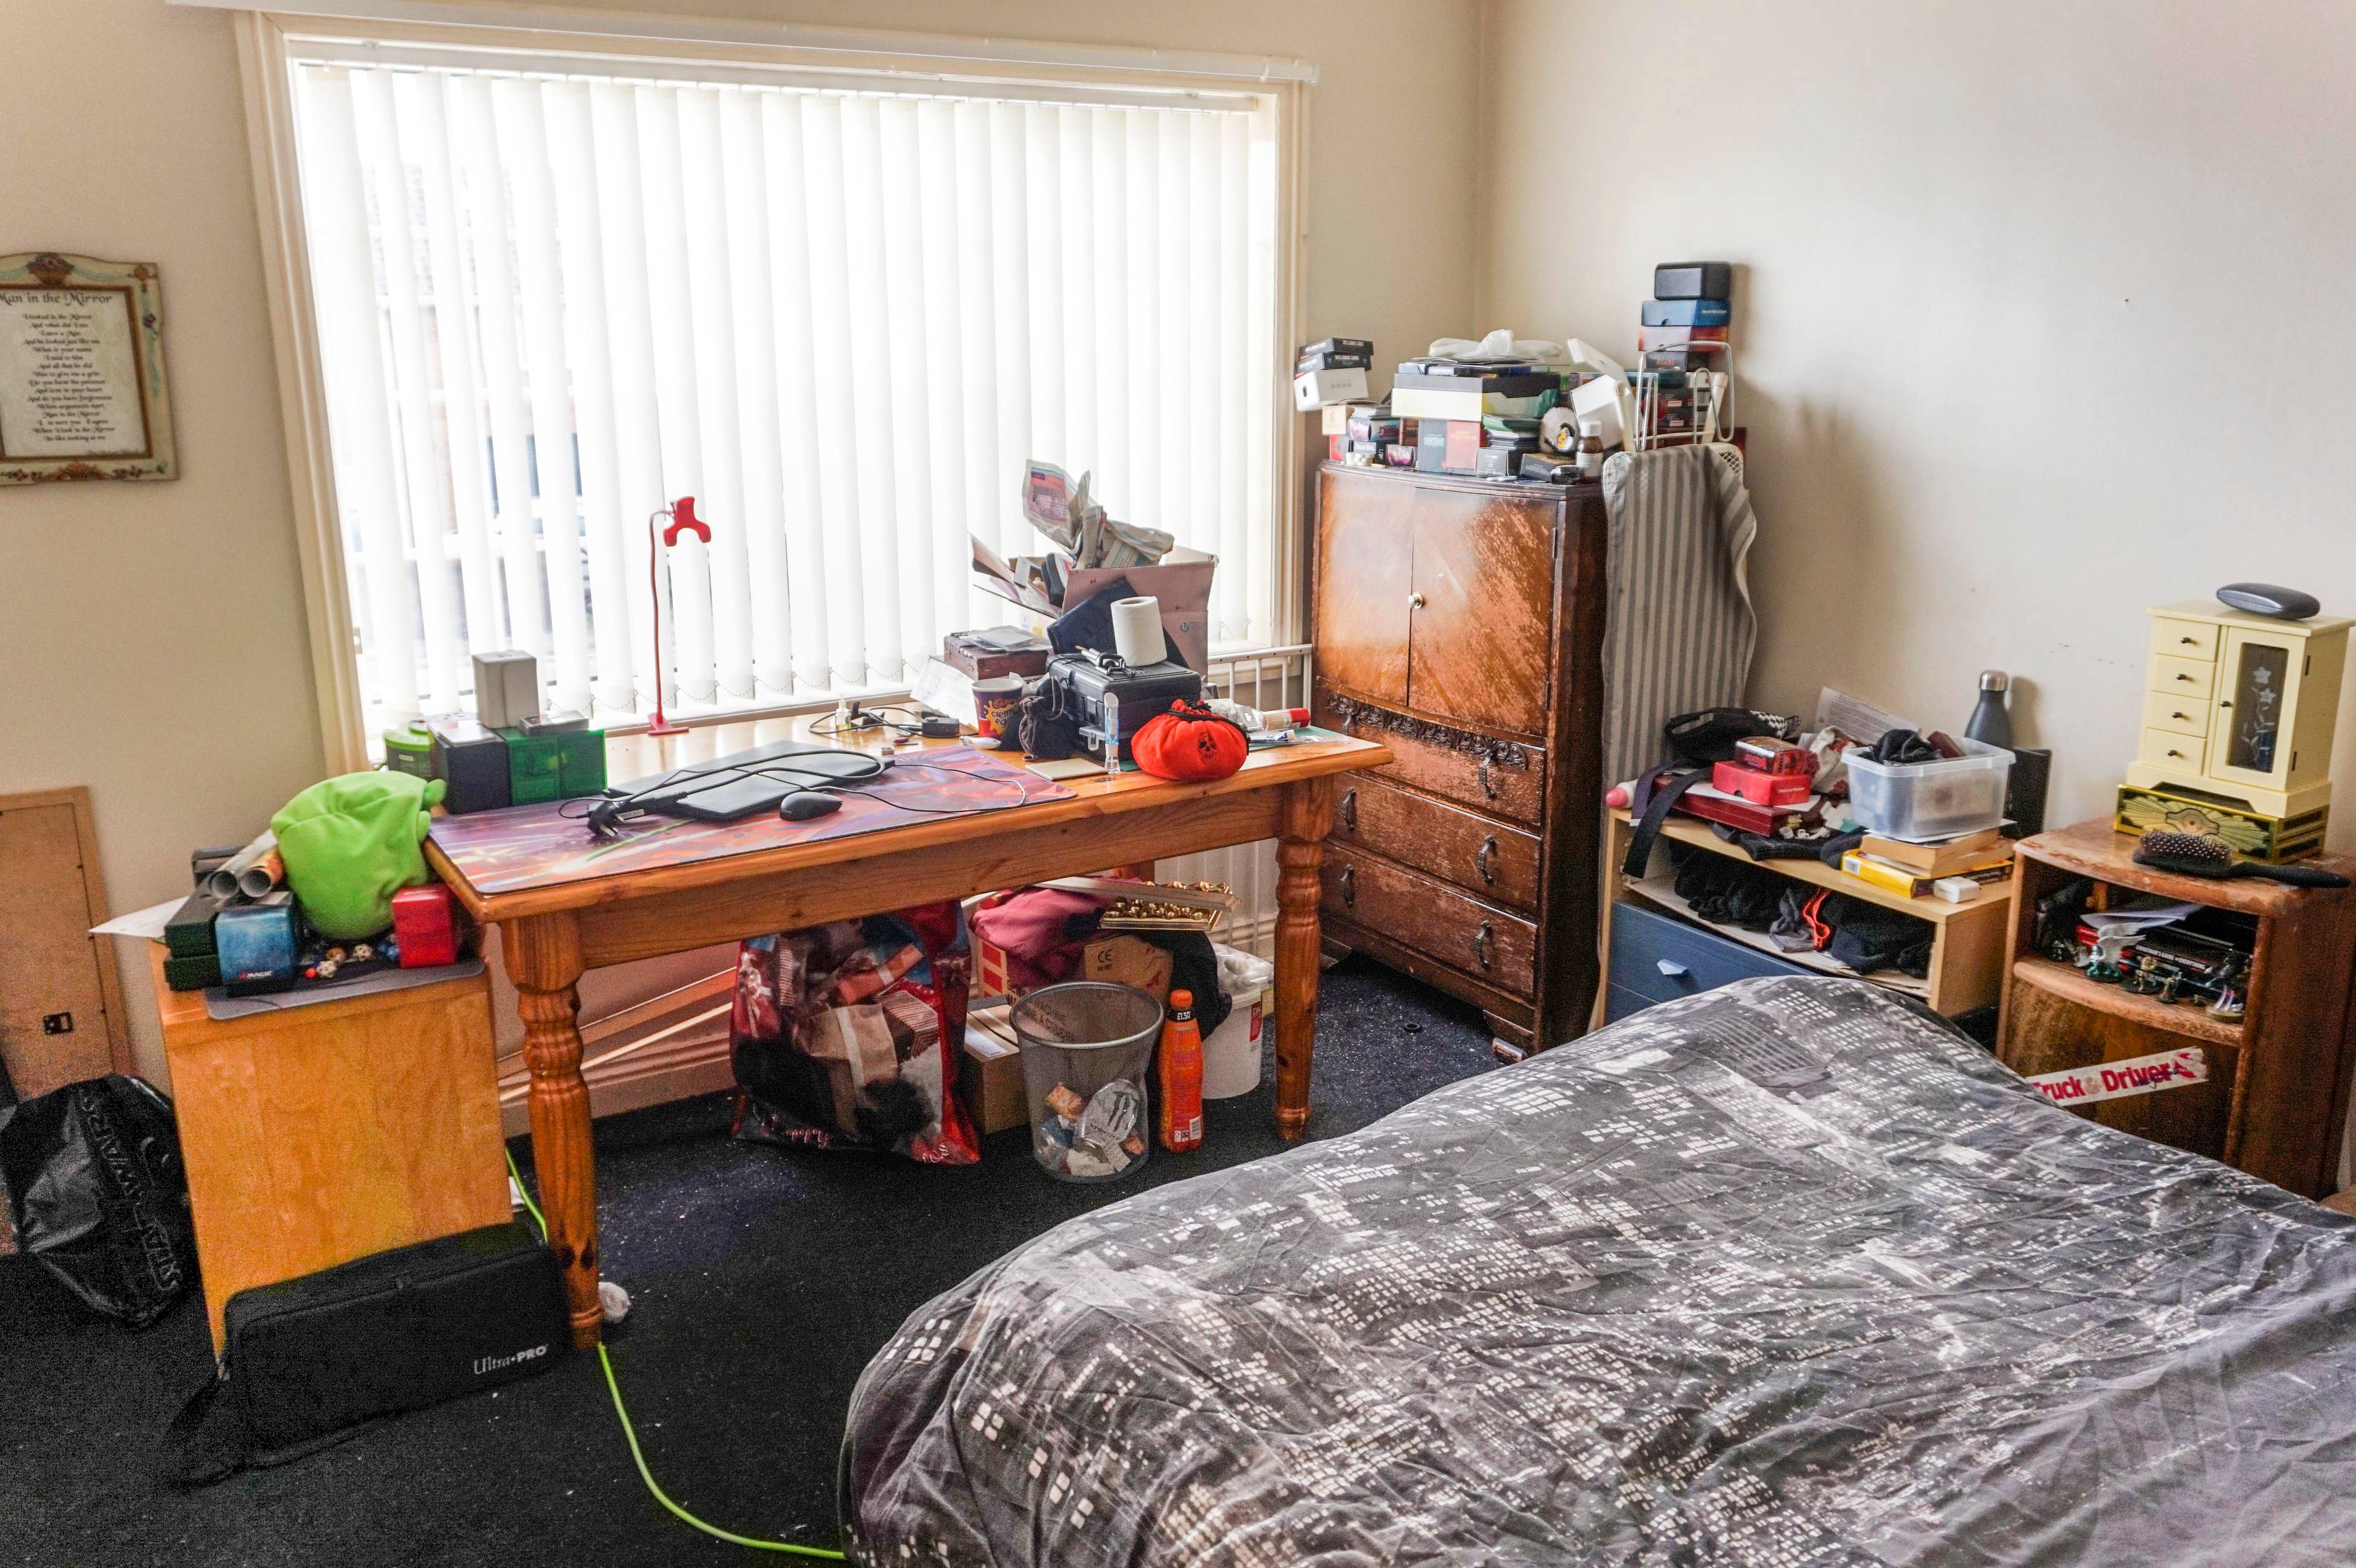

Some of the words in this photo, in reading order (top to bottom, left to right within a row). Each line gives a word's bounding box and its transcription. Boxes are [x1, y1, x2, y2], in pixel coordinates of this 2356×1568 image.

[0, 292, 23, 306] Man
[27, 293, 38, 302] in
[43, 292, 60, 303] the
[64, 292, 112, 306] Mirror
[991, 710, 1012, 718] crem
[1177, 1011, 1191, 1020] £1.50
[2032, 1076, 2086, 1100] ruck
[2100, 1063, 2172, 1093] Driver
